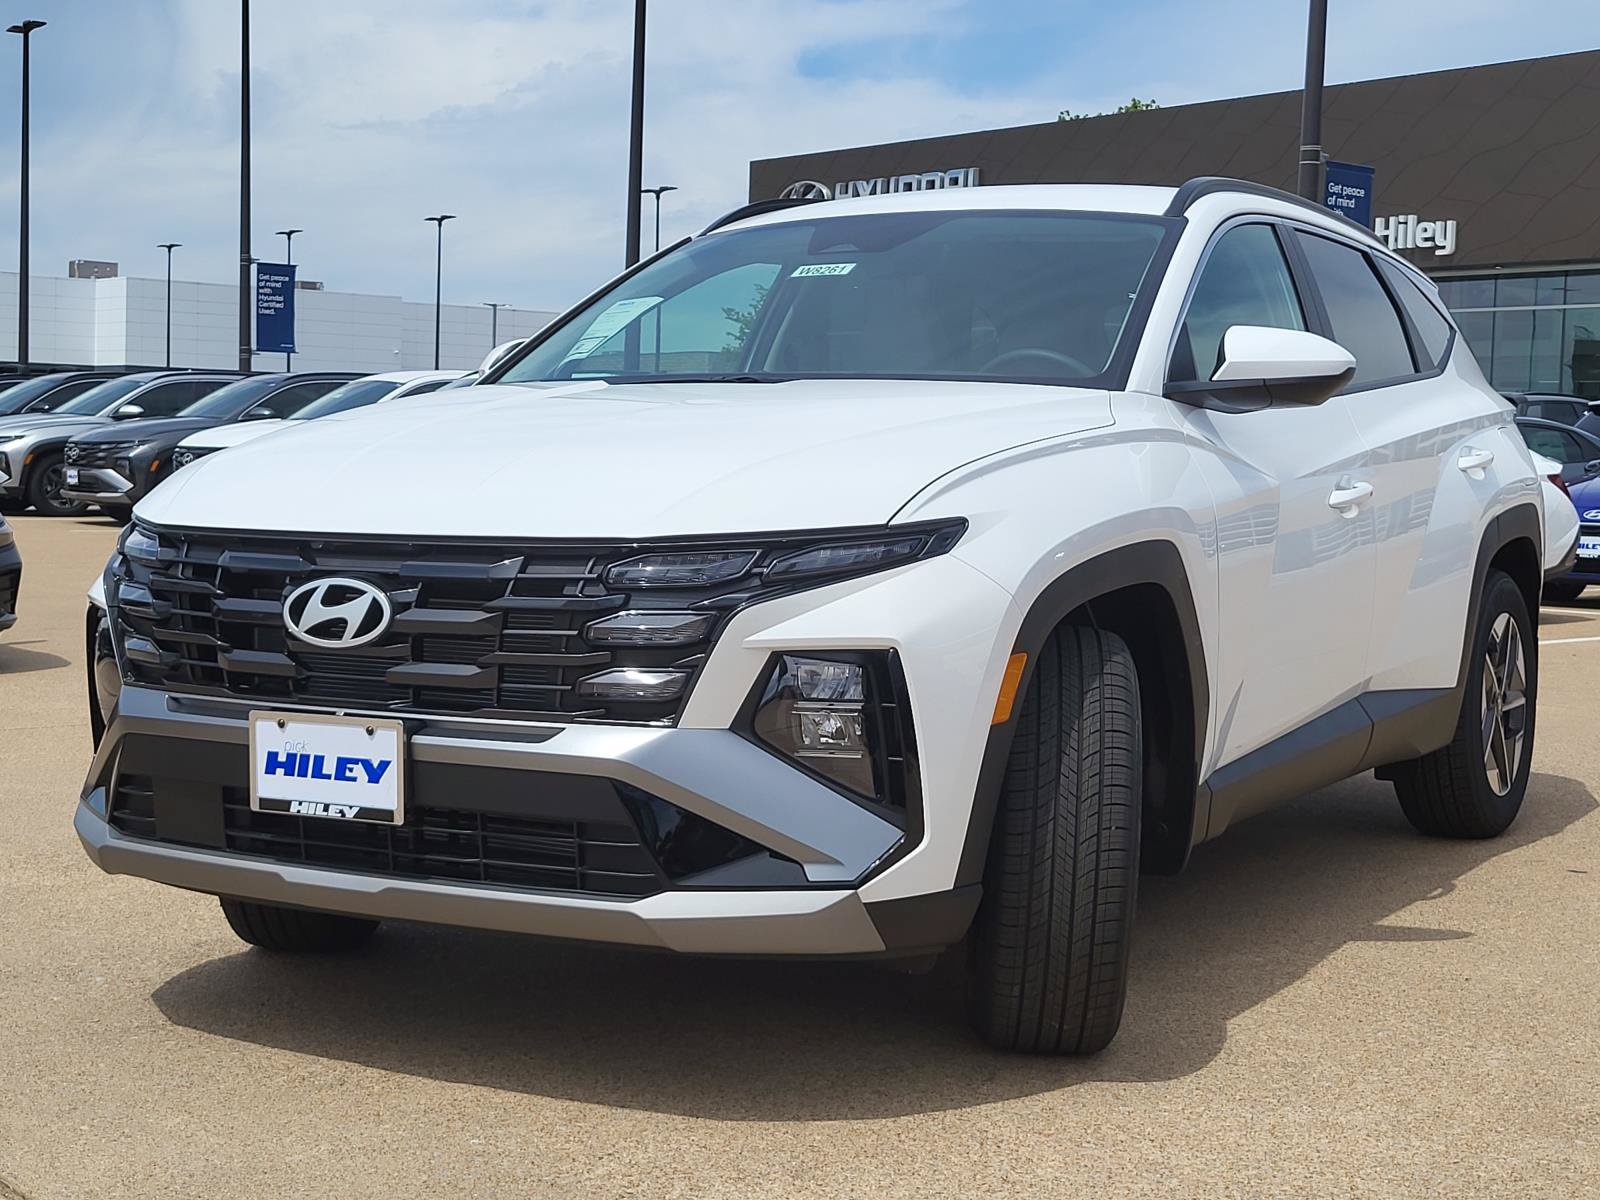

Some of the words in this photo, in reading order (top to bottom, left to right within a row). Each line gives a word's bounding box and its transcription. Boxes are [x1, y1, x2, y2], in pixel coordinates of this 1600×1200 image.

[1328, 182, 1342, 194] Get
[1342, 186, 1365, 198] peace
[1327, 195, 1336, 206] of
[1336, 196, 1355, 208] mind
[1375, 214, 1457, 256] Hiley
[798, 265, 847, 275] W8261
[258, 301, 284, 309] Certified
[264, 750, 392, 784] HILEY
[289, 800, 361, 818] HILEY
